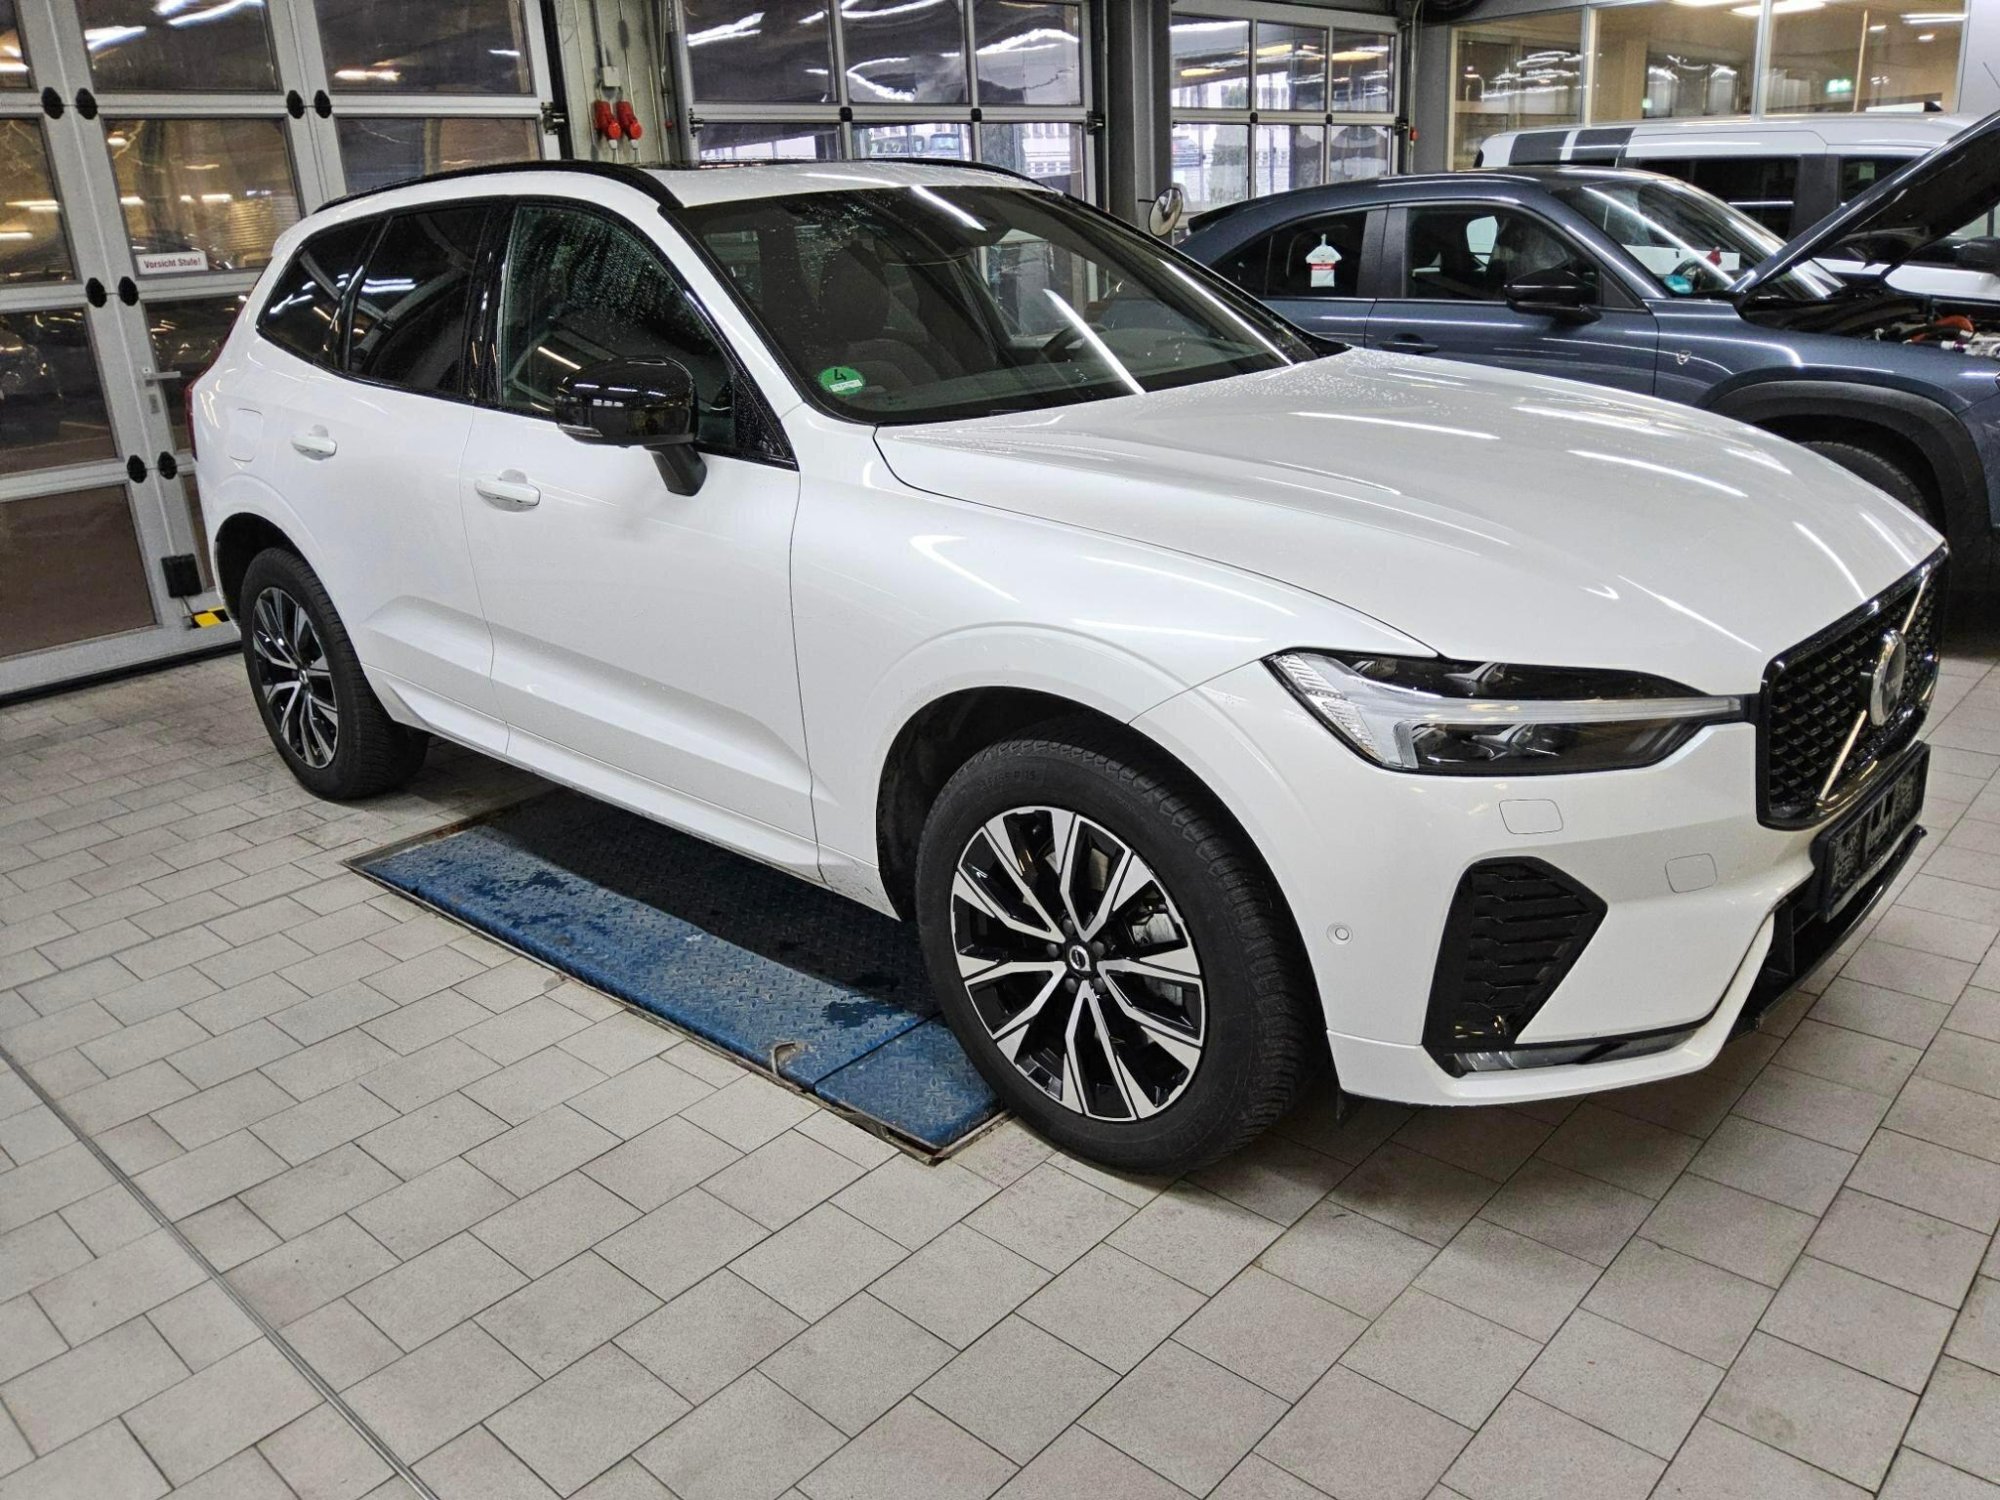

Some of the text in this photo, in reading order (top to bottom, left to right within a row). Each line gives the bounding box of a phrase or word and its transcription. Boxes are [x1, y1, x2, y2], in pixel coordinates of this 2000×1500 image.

[144, 257, 201, 268] Vorsicht Stufe!
[834, 369, 847, 380] 4
